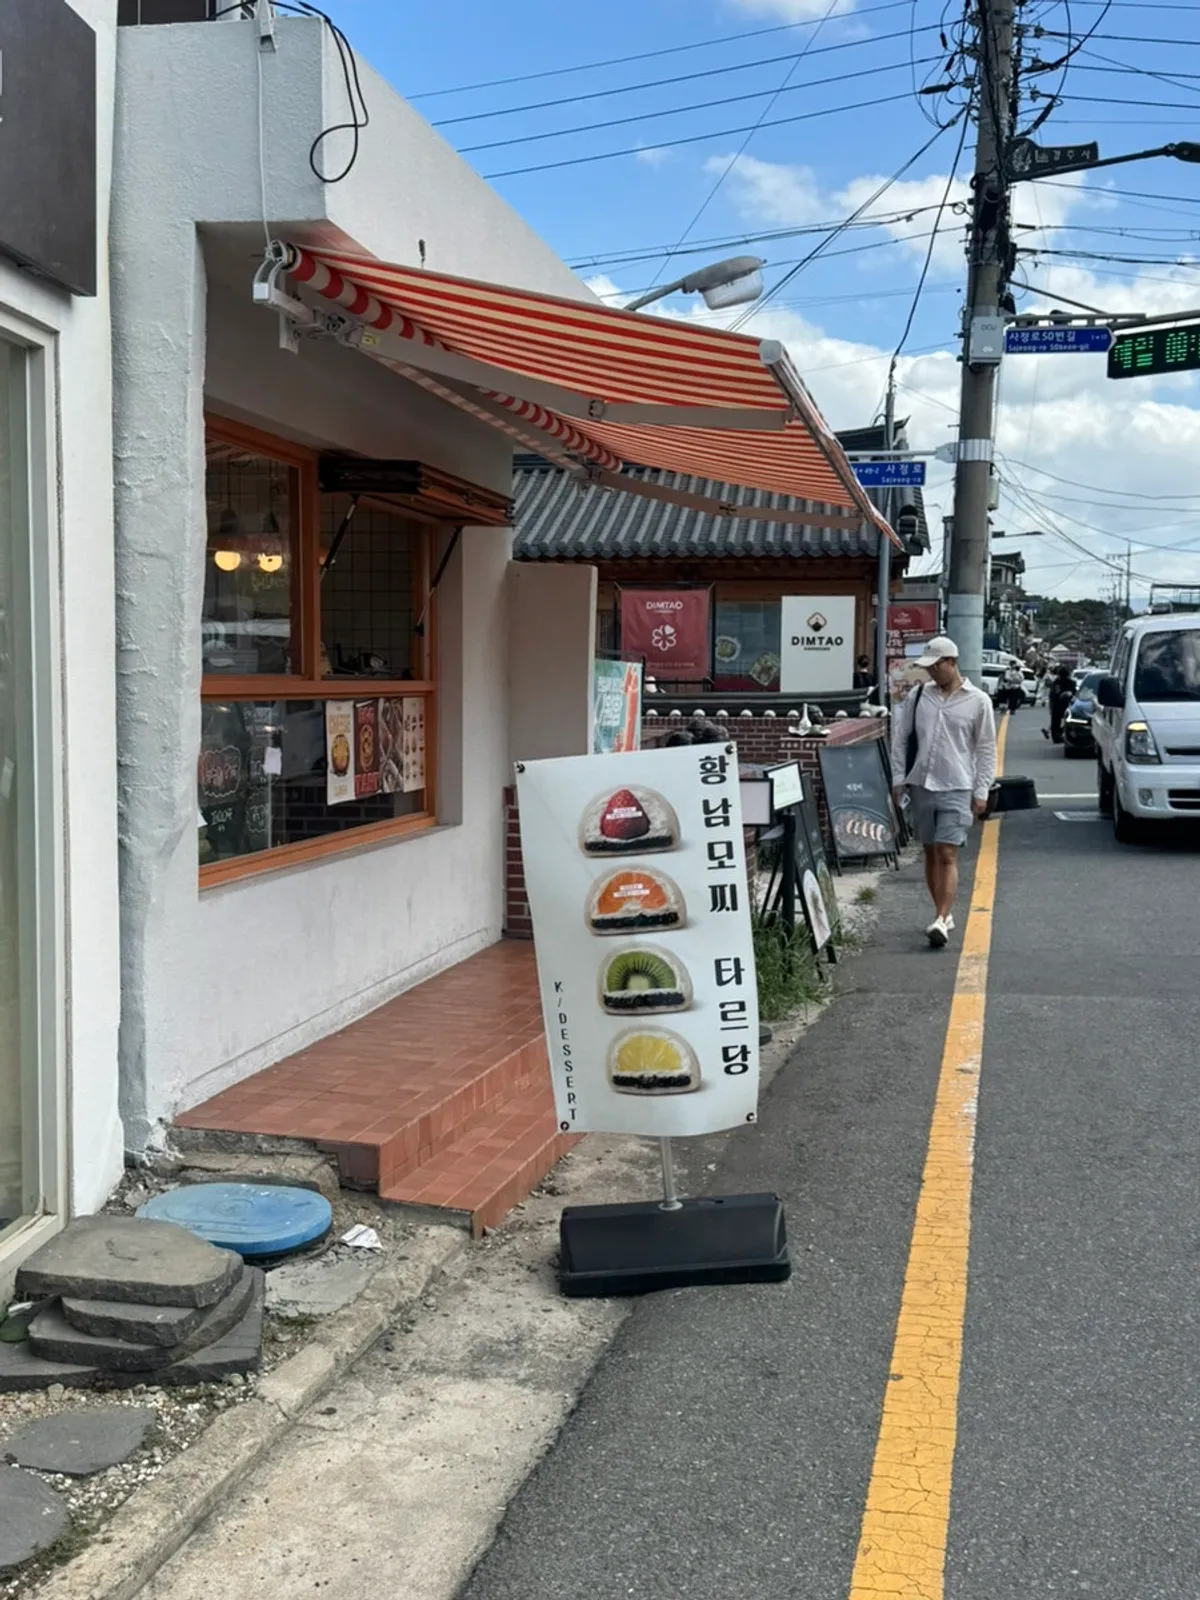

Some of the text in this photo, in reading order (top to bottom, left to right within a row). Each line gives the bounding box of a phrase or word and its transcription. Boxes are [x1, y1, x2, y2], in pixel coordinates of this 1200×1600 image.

[1009, 331, 1076, 343] 사정로50번길
[1008, 344, 1047, 352] Sajeong-ro
[885, 464, 923, 475] 사정로
[881, 476, 922, 484] Sajeong-ro
[646, 601, 683, 610] DIMTAO
[791, 636, 844, 646] DIMTAO
[698, 754, 752, 1076] 황남모찌 타르당
[554, 981, 578, 1121] K/DESSERT
